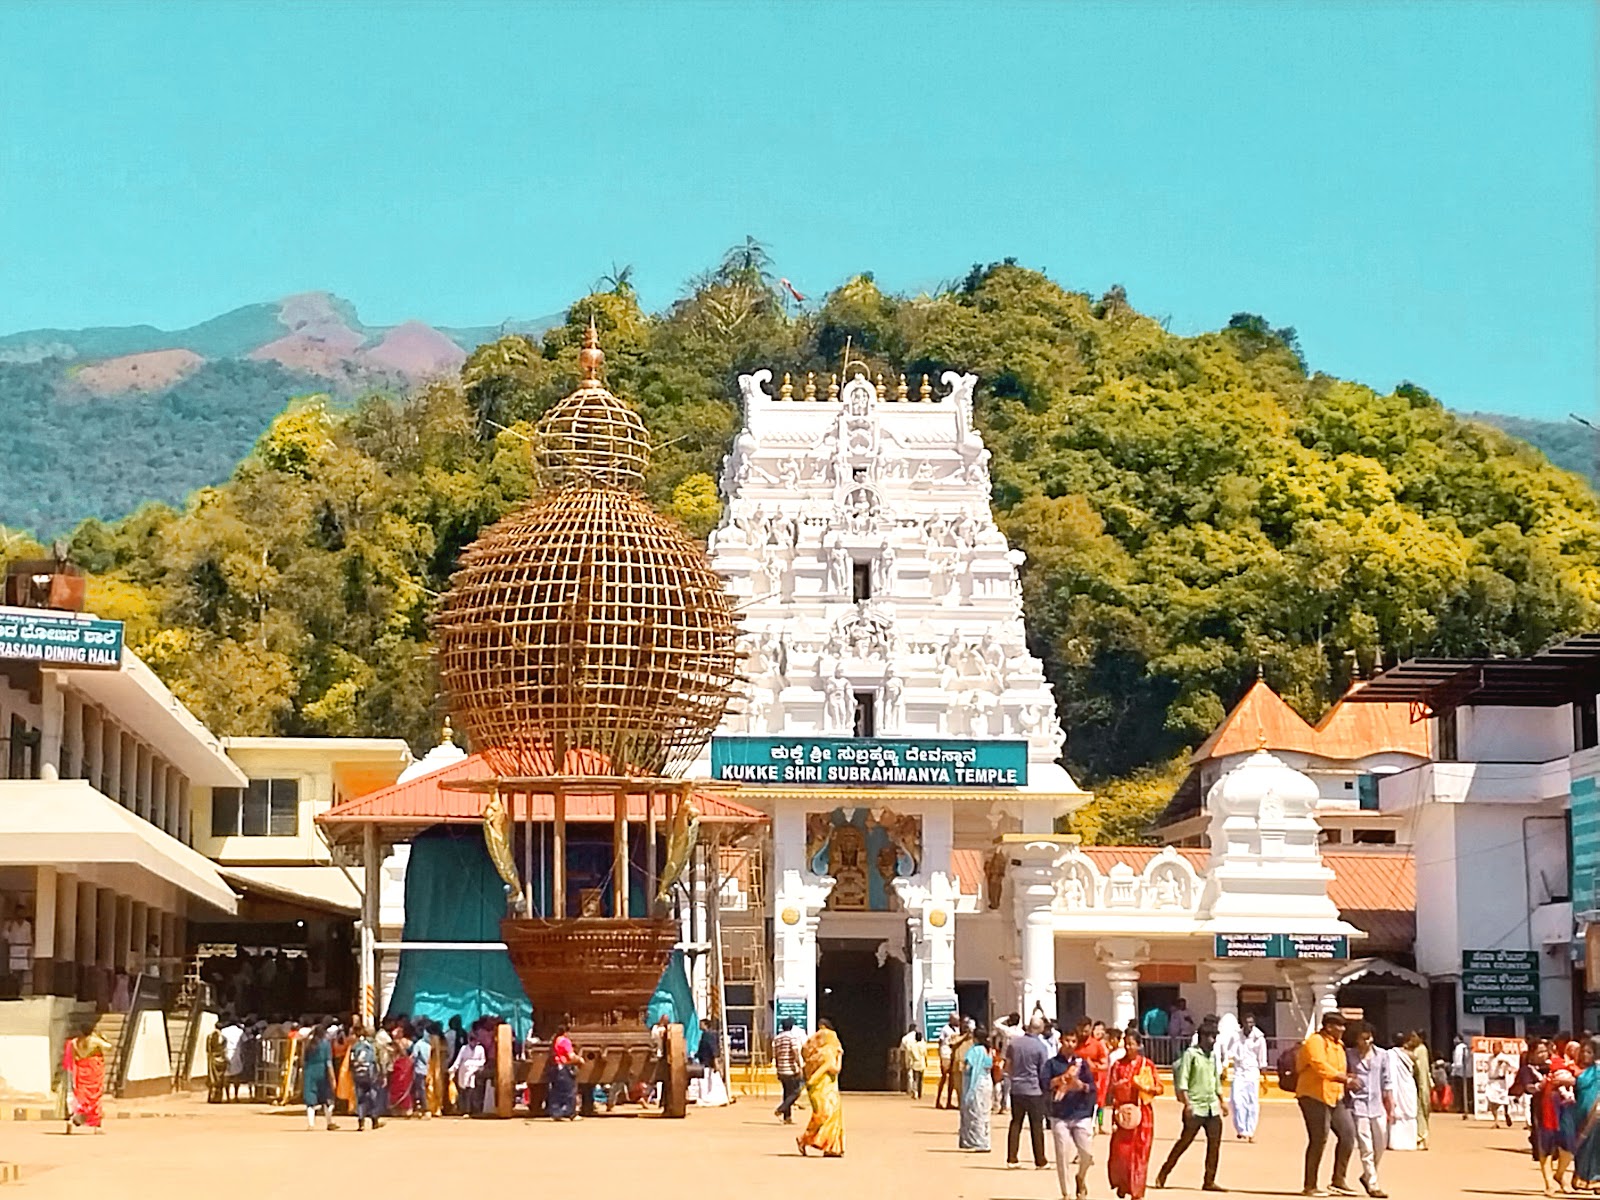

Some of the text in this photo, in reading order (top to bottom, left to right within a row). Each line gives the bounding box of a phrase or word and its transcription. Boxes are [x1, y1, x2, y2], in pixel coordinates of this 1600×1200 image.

[44, 645, 86, 662] DINING
[88, 648, 118, 664] HALL
[771, 745, 804, 765] ಕುಕ್ಕೆ
[810, 745, 832, 763] ಶ್ರೀ
[837, 745, 899, 767] ಸುಬ್ರಹ್ಮಣ್ಯ
[722, 765, 1018, 783] KUKKE SHRI SUBRAHMANYA TEMPLE
[1294, 943, 1336, 951] PROTOCOL
[1298, 951, 1333, 959] SECTION
